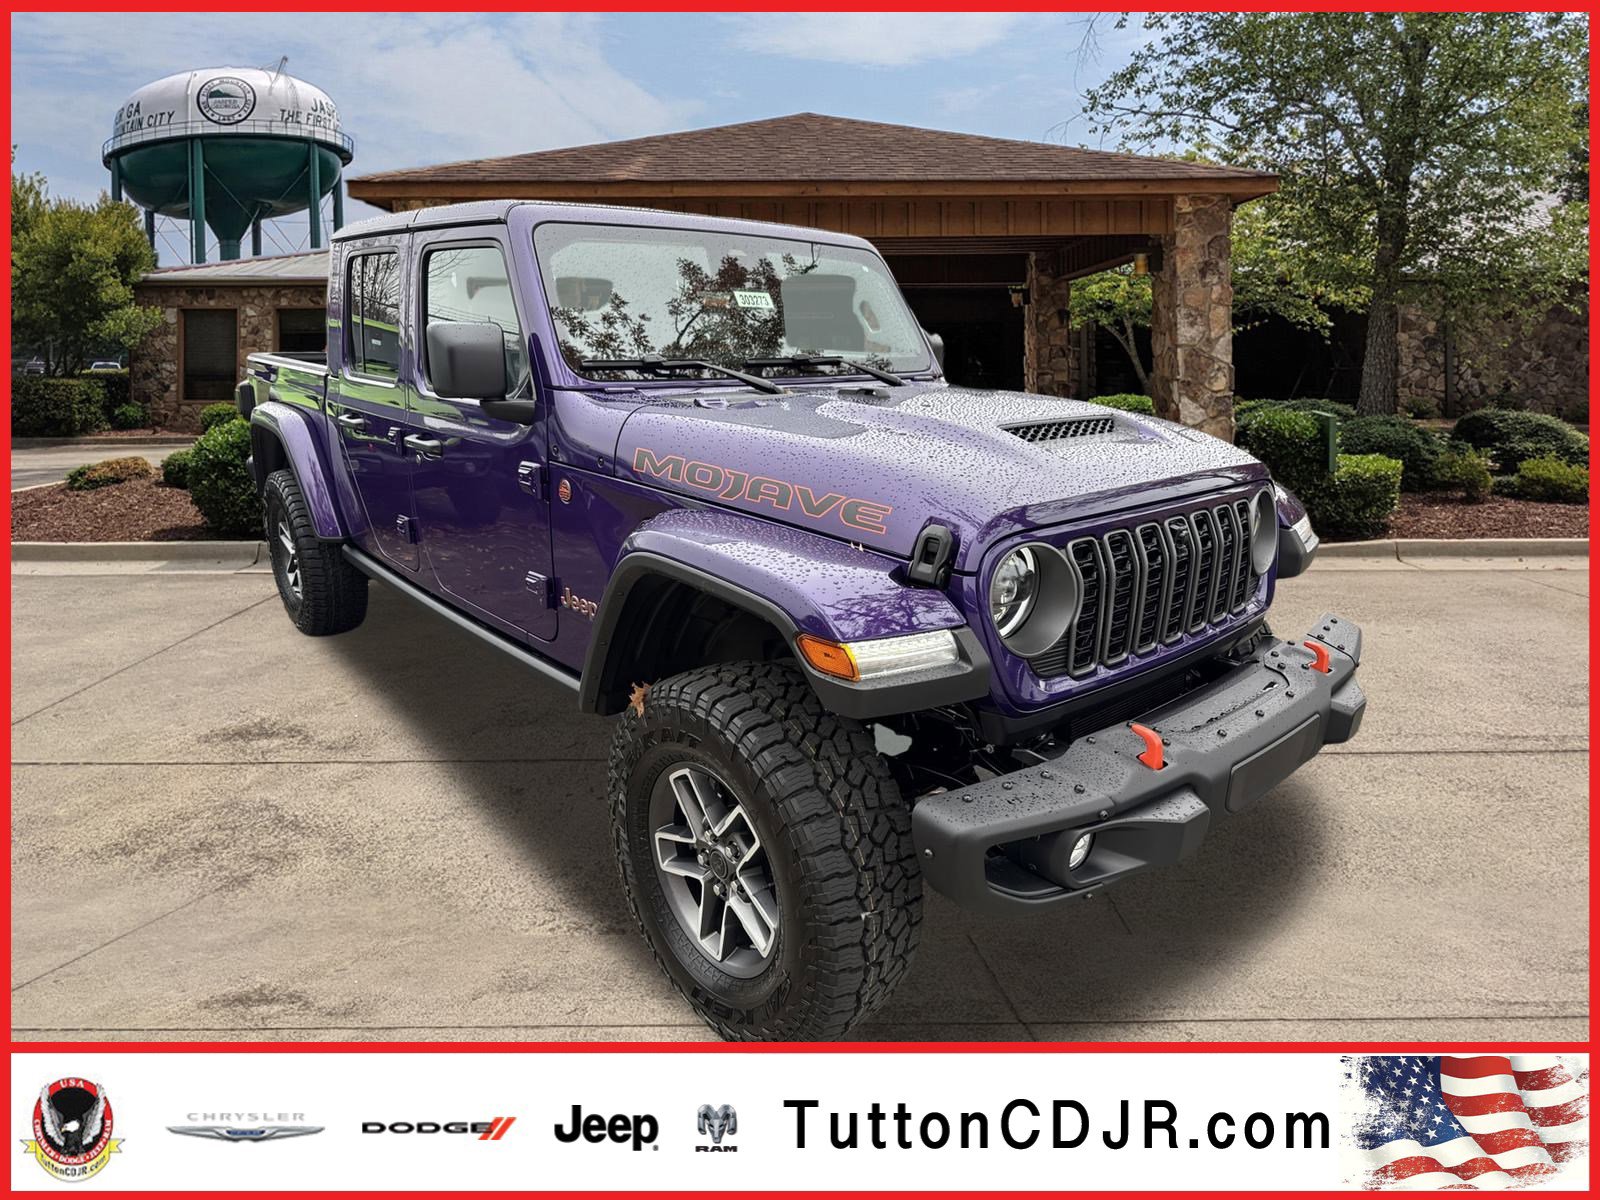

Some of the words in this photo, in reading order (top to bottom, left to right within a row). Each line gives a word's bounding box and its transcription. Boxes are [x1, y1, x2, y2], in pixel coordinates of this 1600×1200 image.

[126, 100, 141, 119] GA
[147, 110, 176, 127] CITY
[280, 109, 302, 123] THE
[306, 112, 331, 129] FIRST
[740, 294, 770, 306] 303273
[633, 447, 892, 534] MOJAVE
[560, 587, 598, 622] Jeep
